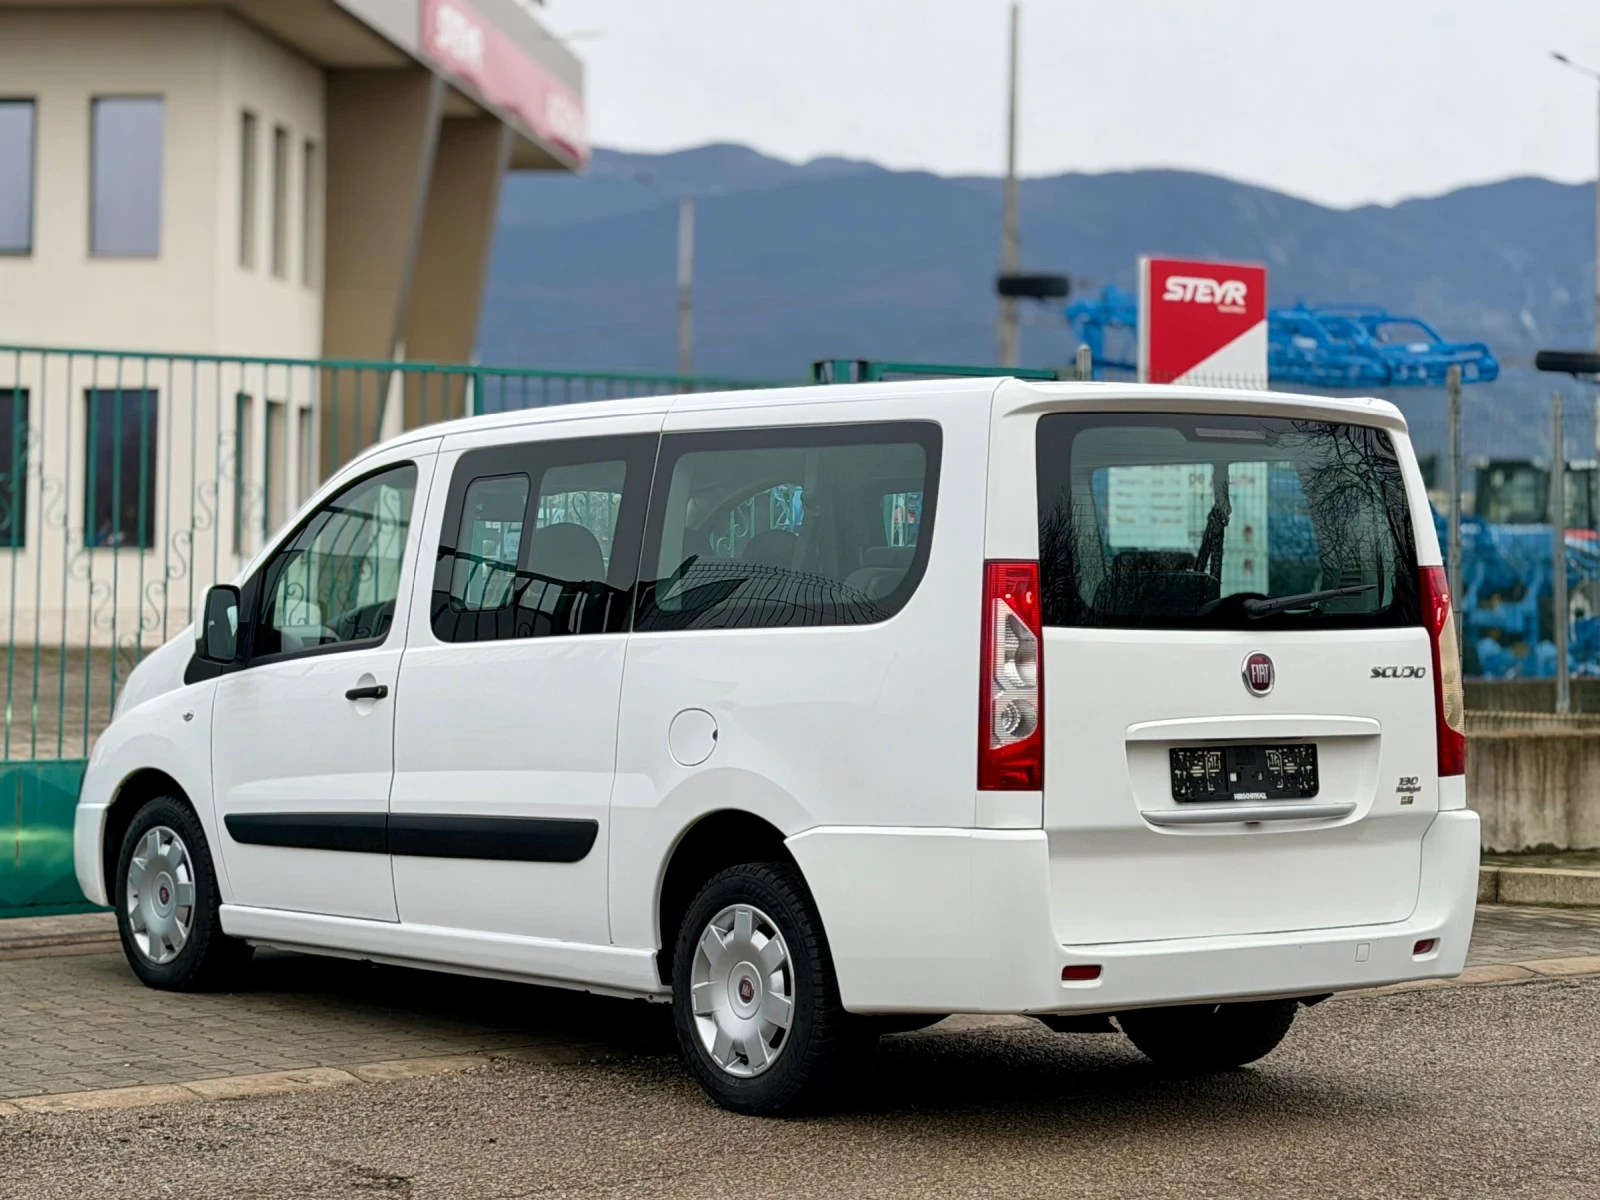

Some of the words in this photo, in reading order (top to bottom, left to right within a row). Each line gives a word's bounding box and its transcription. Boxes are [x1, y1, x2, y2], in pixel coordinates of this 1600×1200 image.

[1163, 275, 1247, 305] STEYR
[1250, 663, 1269, 684] FIAT
[1370, 665, 1427, 679] SCUDO
[1398, 776, 1419, 786] 130
